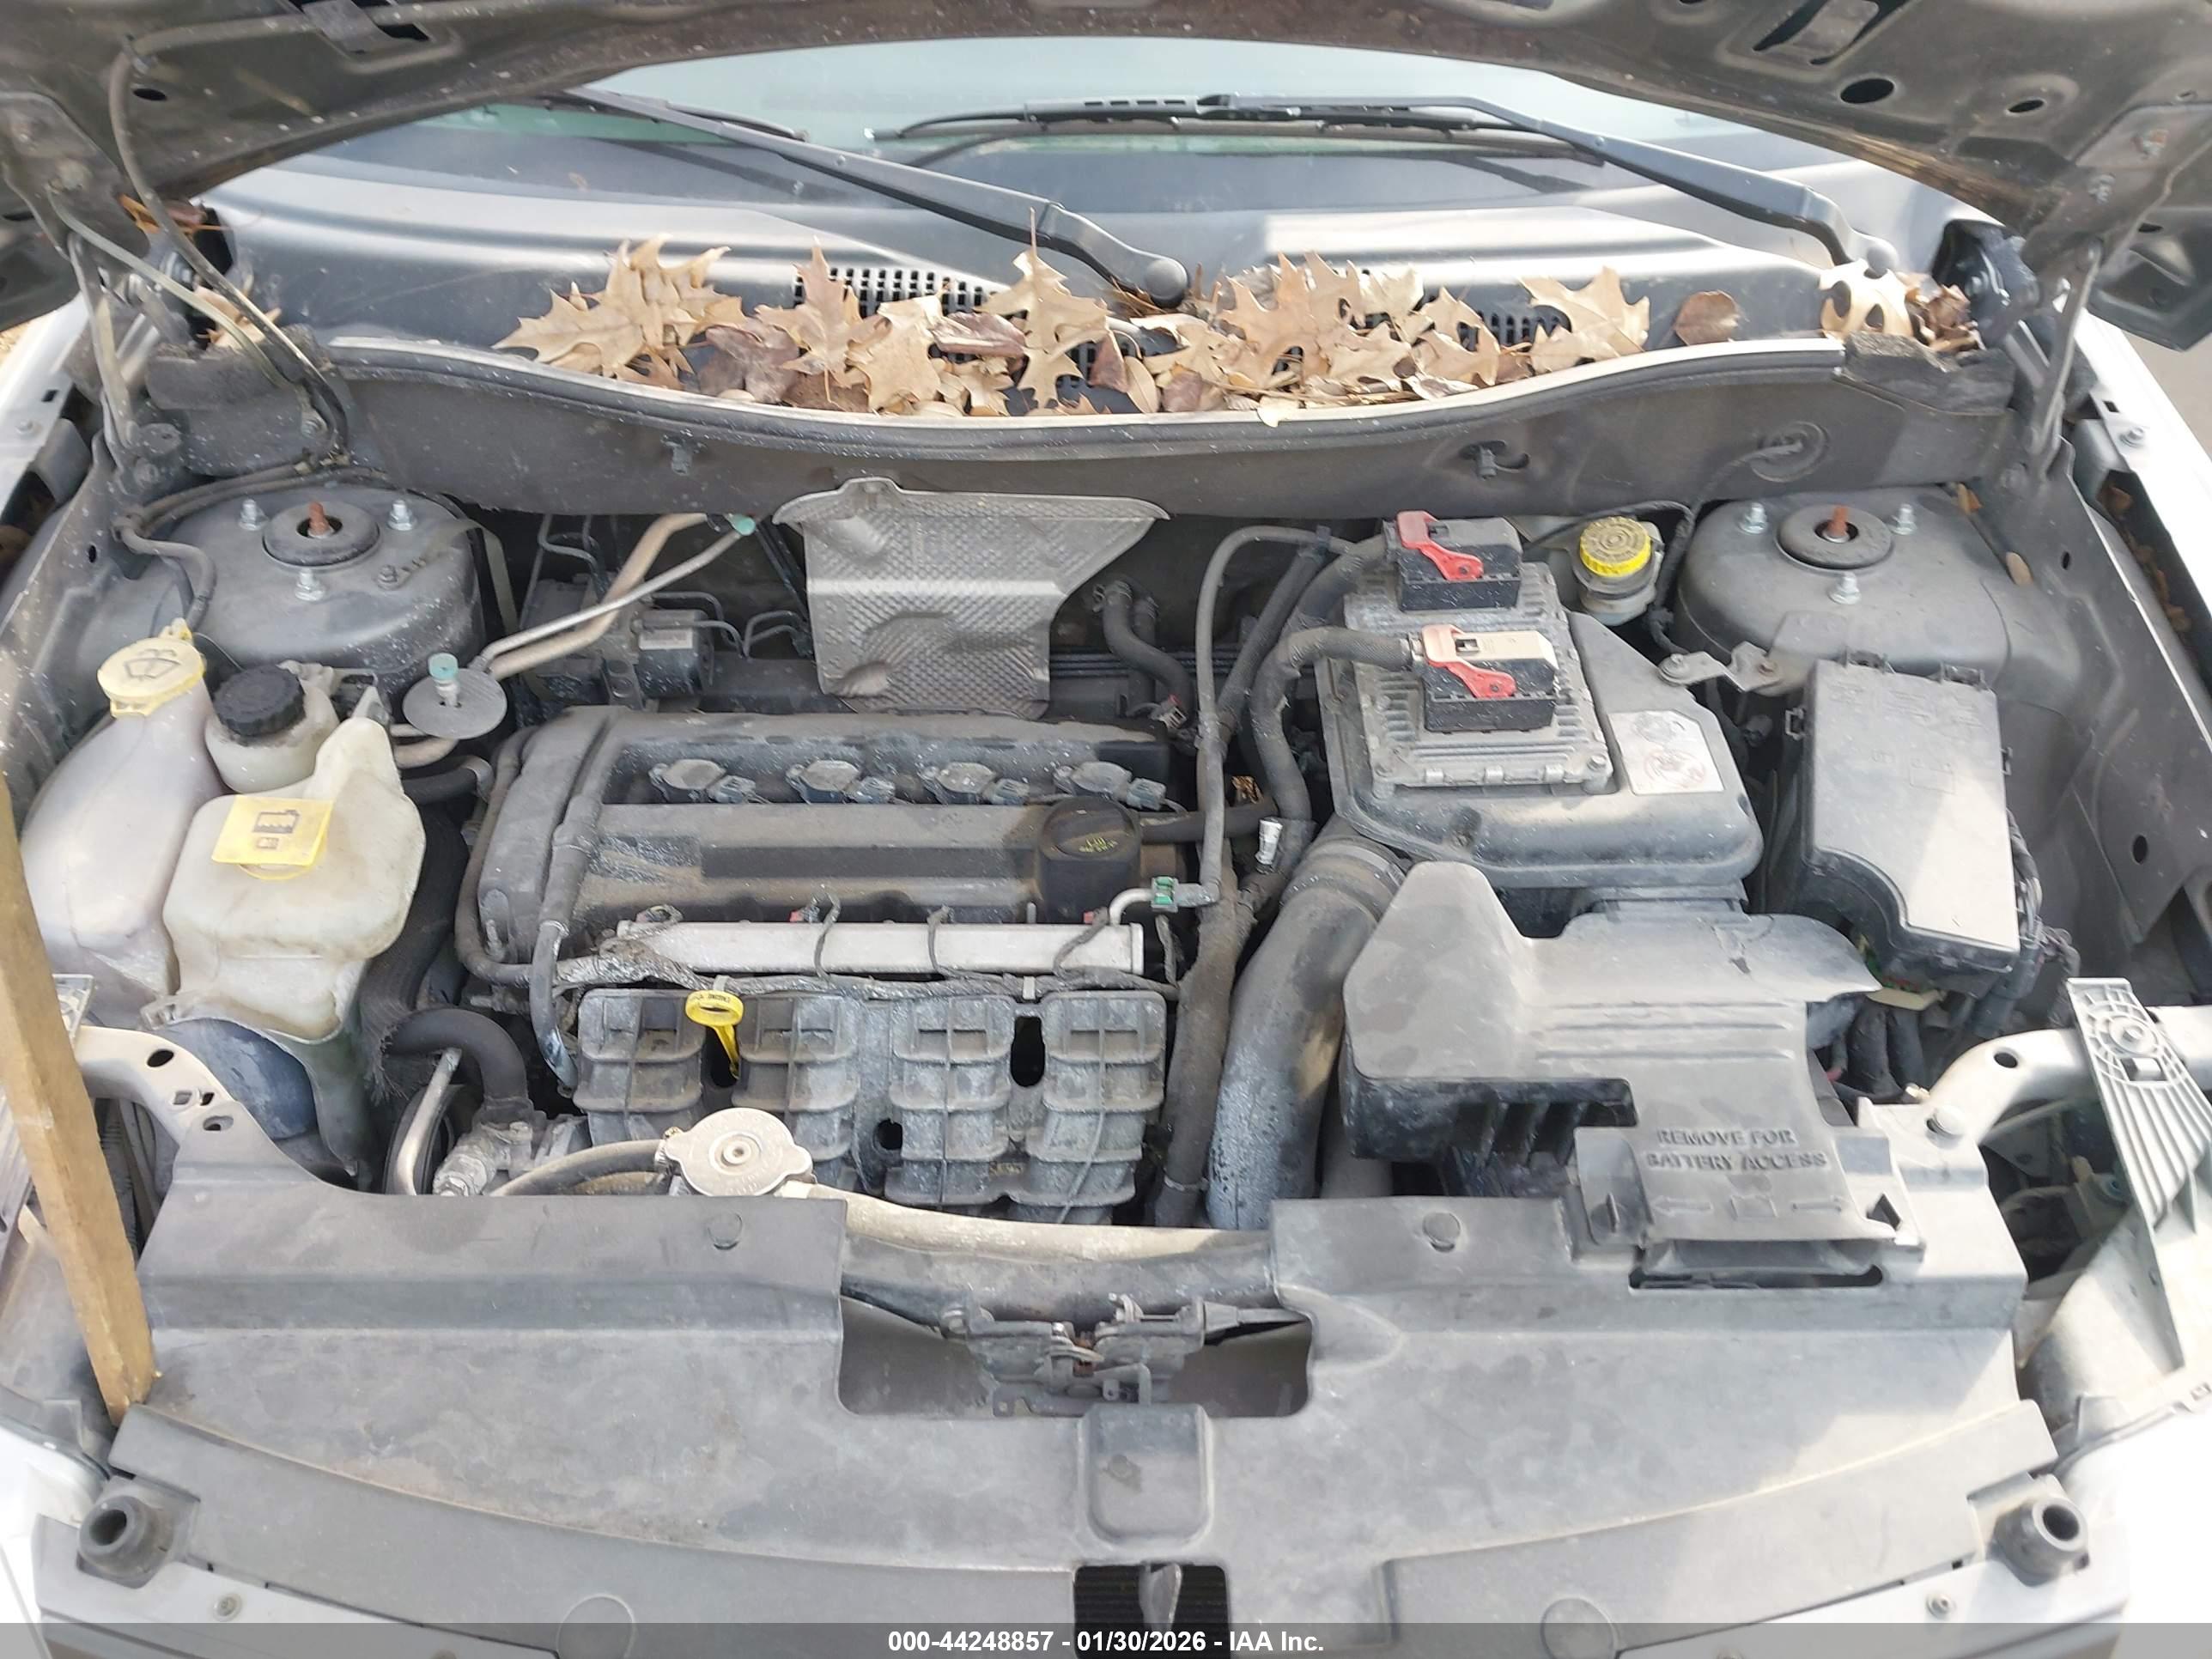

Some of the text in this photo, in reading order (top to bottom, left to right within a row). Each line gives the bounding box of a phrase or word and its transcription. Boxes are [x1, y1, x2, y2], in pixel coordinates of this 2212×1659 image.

[1656, 1127, 1799, 1146] REMOVE FOR
[1646, 1152, 1829, 1170] BATTERY ACCESS
